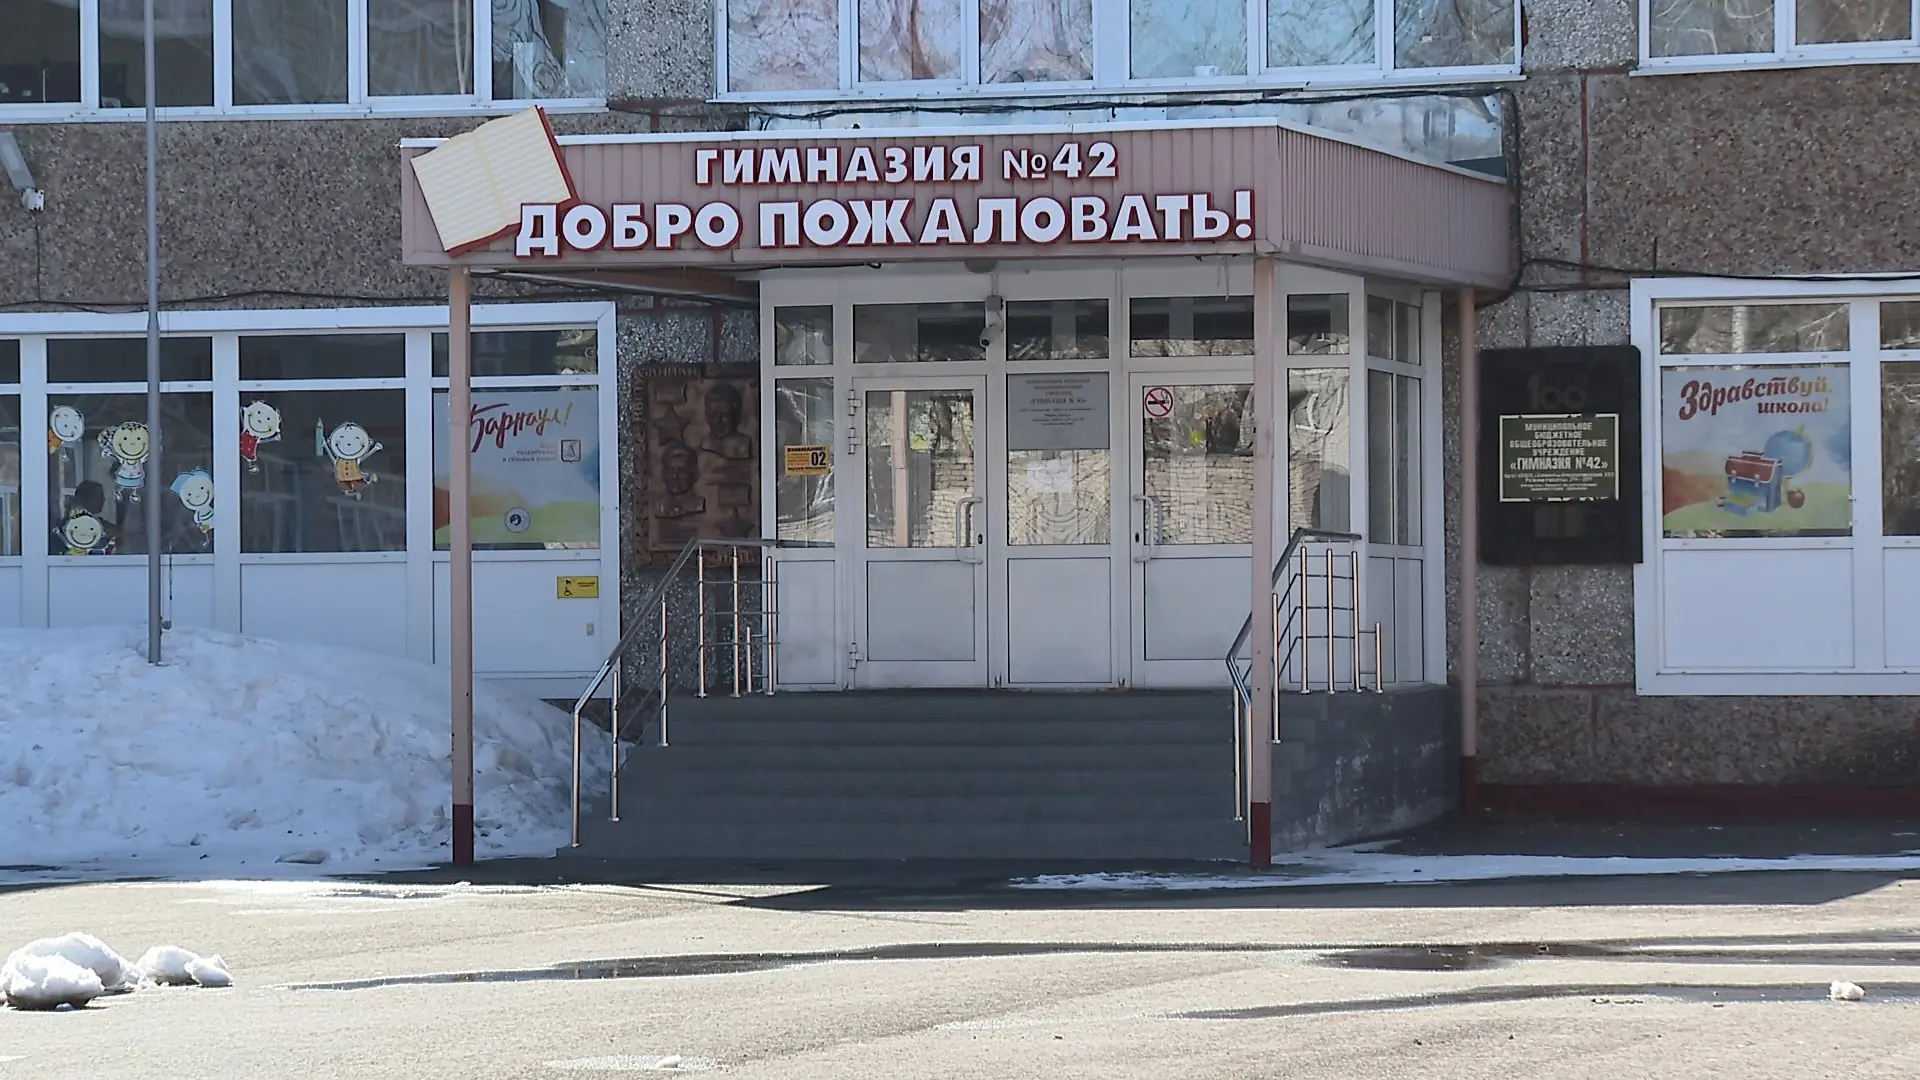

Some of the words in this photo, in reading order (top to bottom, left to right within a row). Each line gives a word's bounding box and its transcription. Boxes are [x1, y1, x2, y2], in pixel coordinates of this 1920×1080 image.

[696, 145, 982, 184] ГИМНАЗИЯ
[515, 200, 741, 257] ДОБРО
[759, 188, 1254, 248] ПОЖАЛОВАТЬ!
[1757, 398, 1829, 414] школа!
[470, 402, 573, 453] Барнаул!
[1525, 422, 1592, 431] МУНИЦИПАЛЬНОЕ
[1535, 431, 1583, 439] БЮДЖЕТНОЕ
[1510, 439, 1608, 448] ОБЩЕОБРАЗОВАТЕЛЬНОЕ
[811, 451, 827, 466] 02
[1532, 448, 1585, 456] УЧРЕЖДЕНИЕ
[1510, 457, 1571, 470] «ГИМНАЗИЯ
